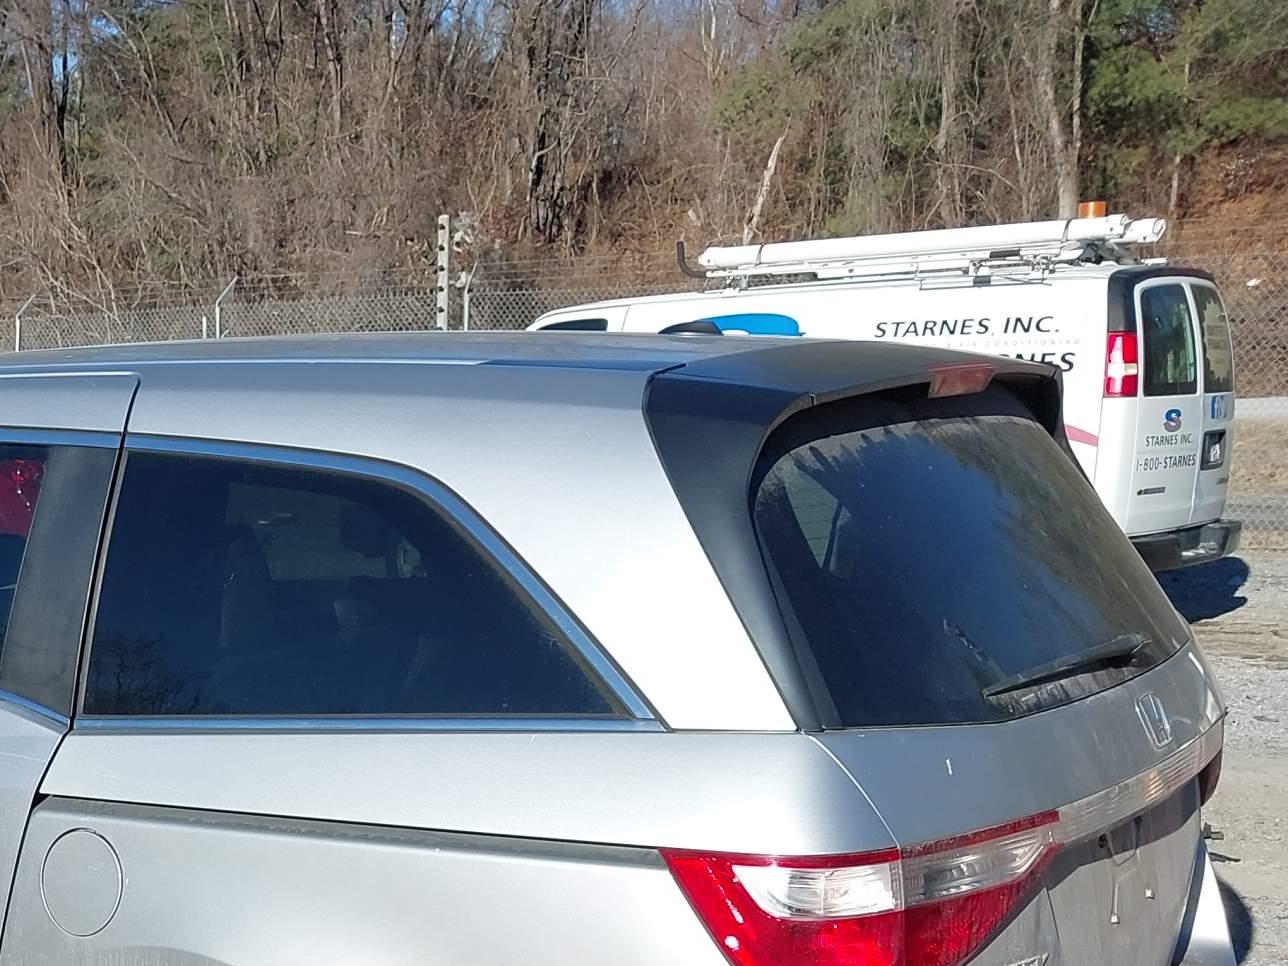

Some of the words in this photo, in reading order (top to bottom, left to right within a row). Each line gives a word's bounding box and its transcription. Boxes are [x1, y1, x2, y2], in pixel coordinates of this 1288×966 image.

[874, 317, 996, 338] STARNES,
[1002, 315, 1060, 335] INC.
[1145, 434, 1179, 447] STARNES
[1136, 454, 1196, 472] 1-800-STARNES
